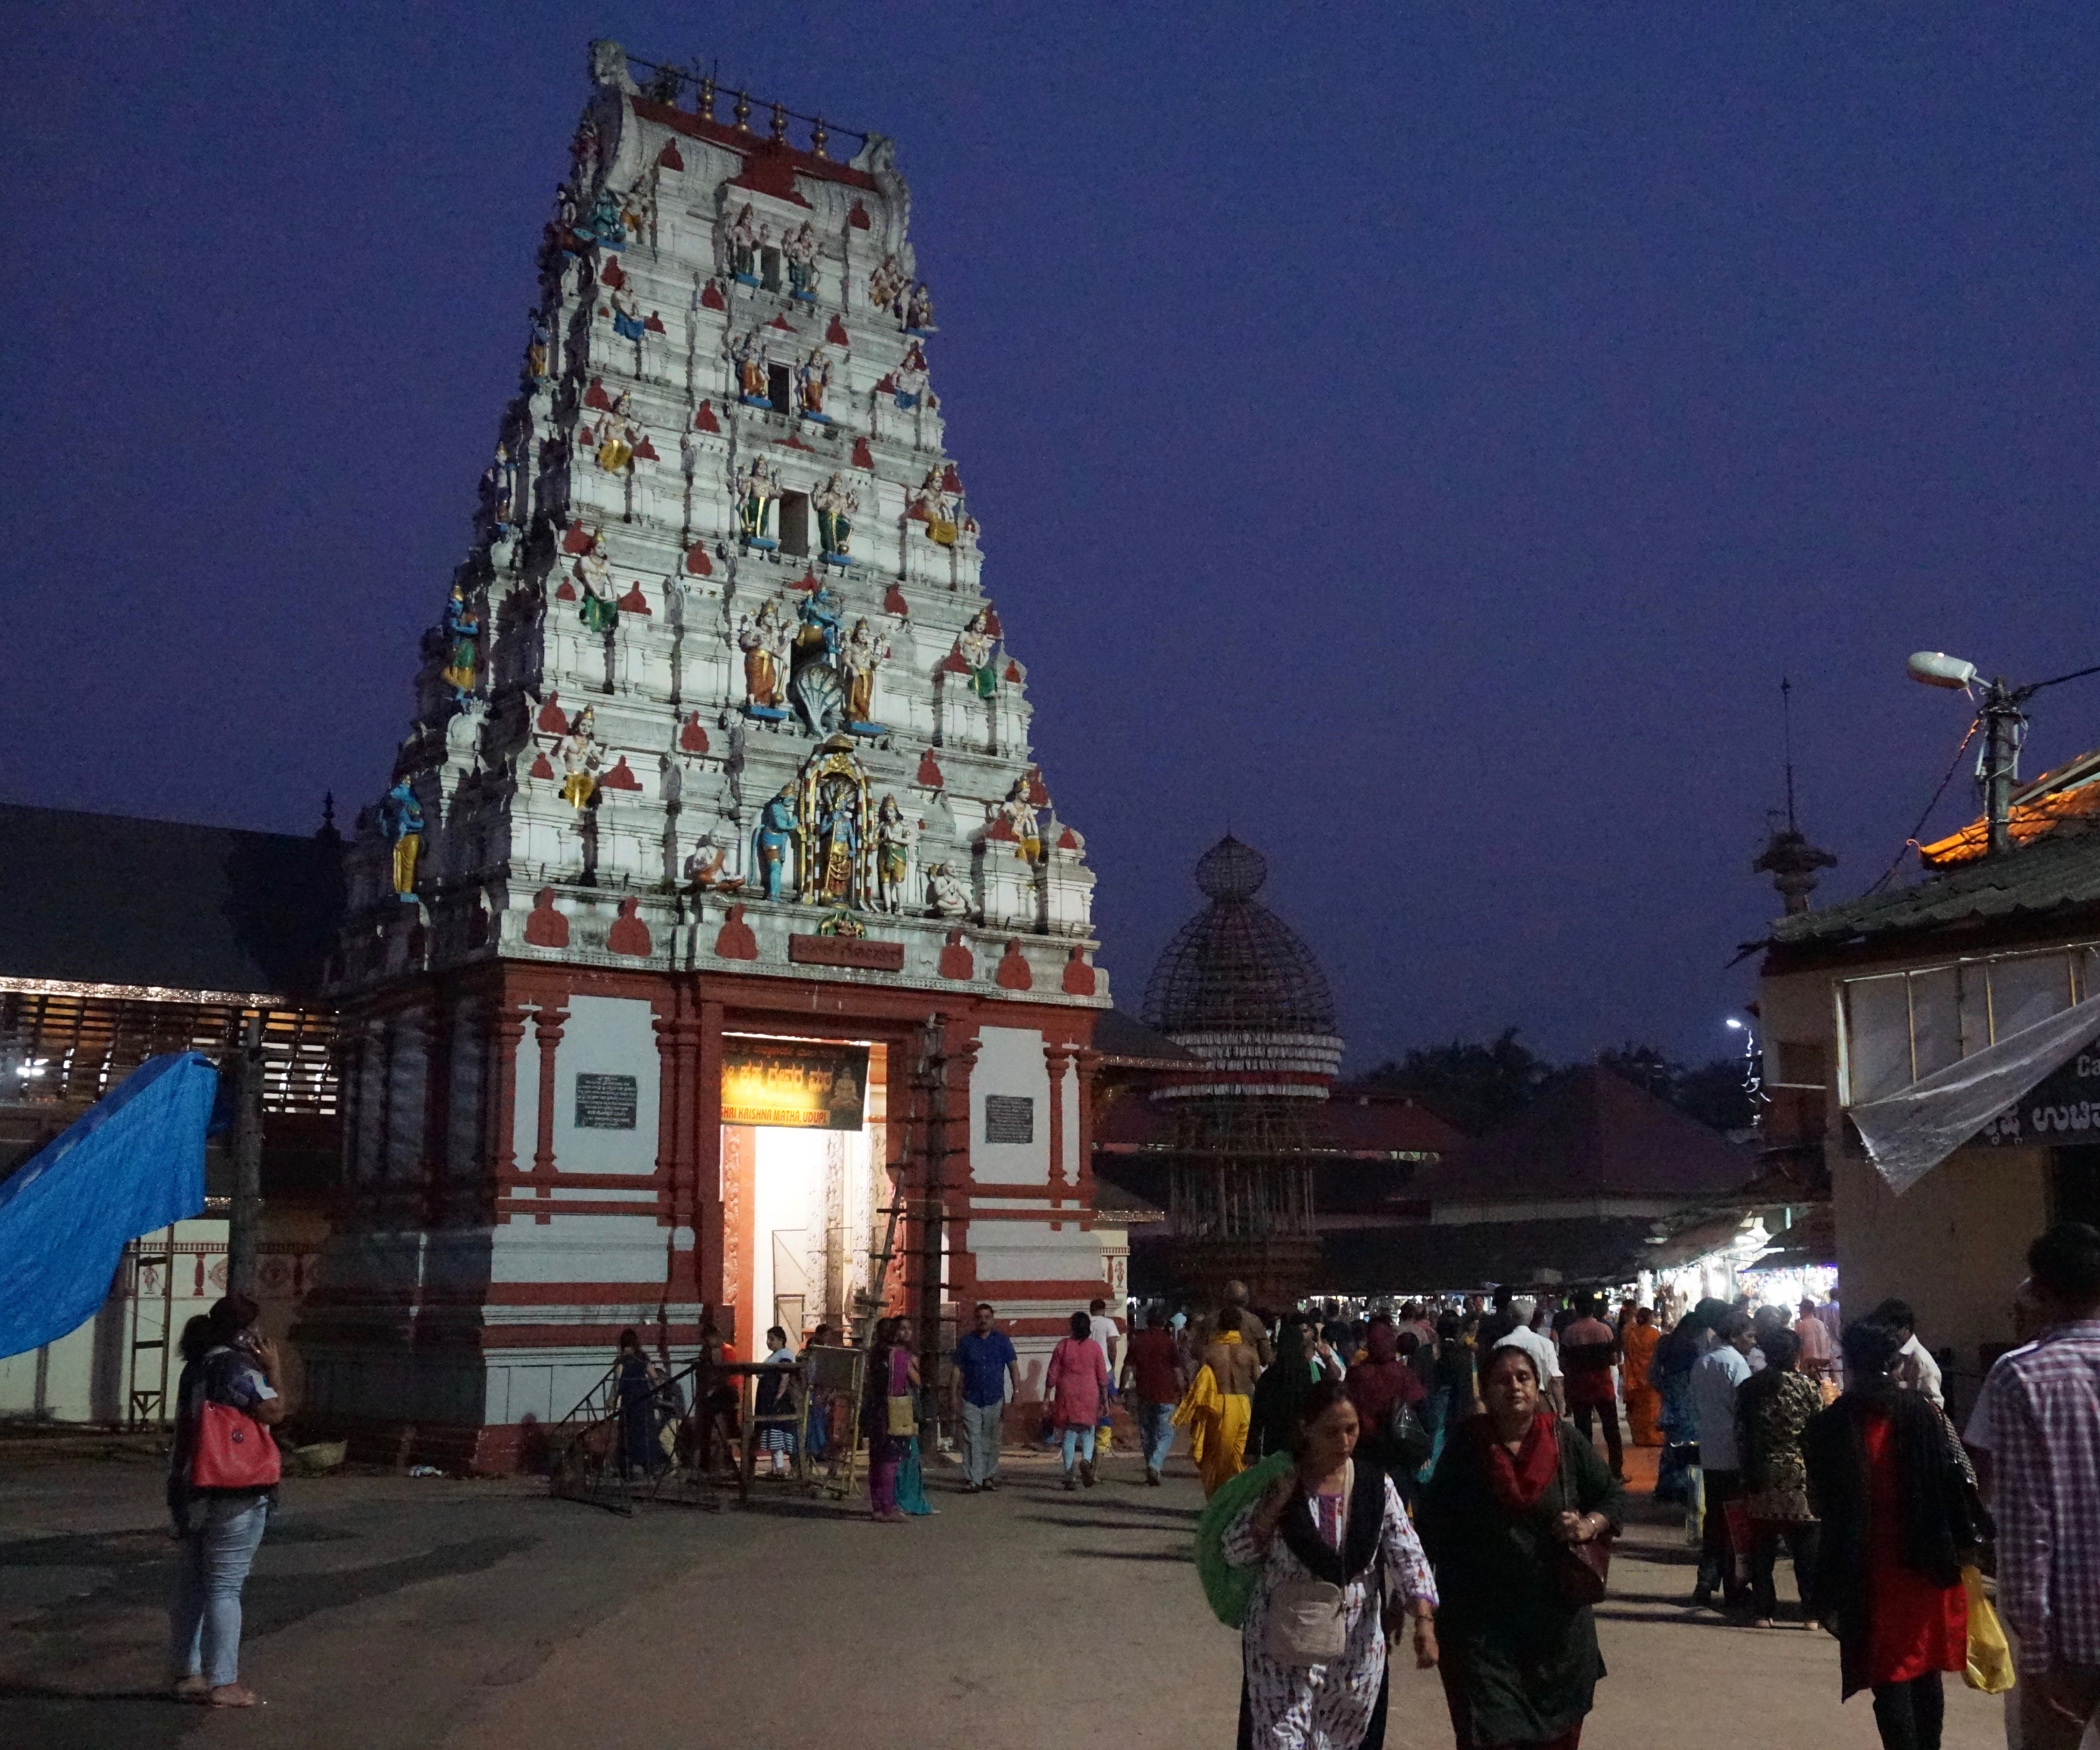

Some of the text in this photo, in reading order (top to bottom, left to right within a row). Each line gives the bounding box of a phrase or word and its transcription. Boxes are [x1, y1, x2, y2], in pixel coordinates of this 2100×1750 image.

[721, 1106, 736, 1118] SHRI
[739, 1108, 771, 1120] KRISHNA
[774, 1110, 801, 1123] MATHA,
